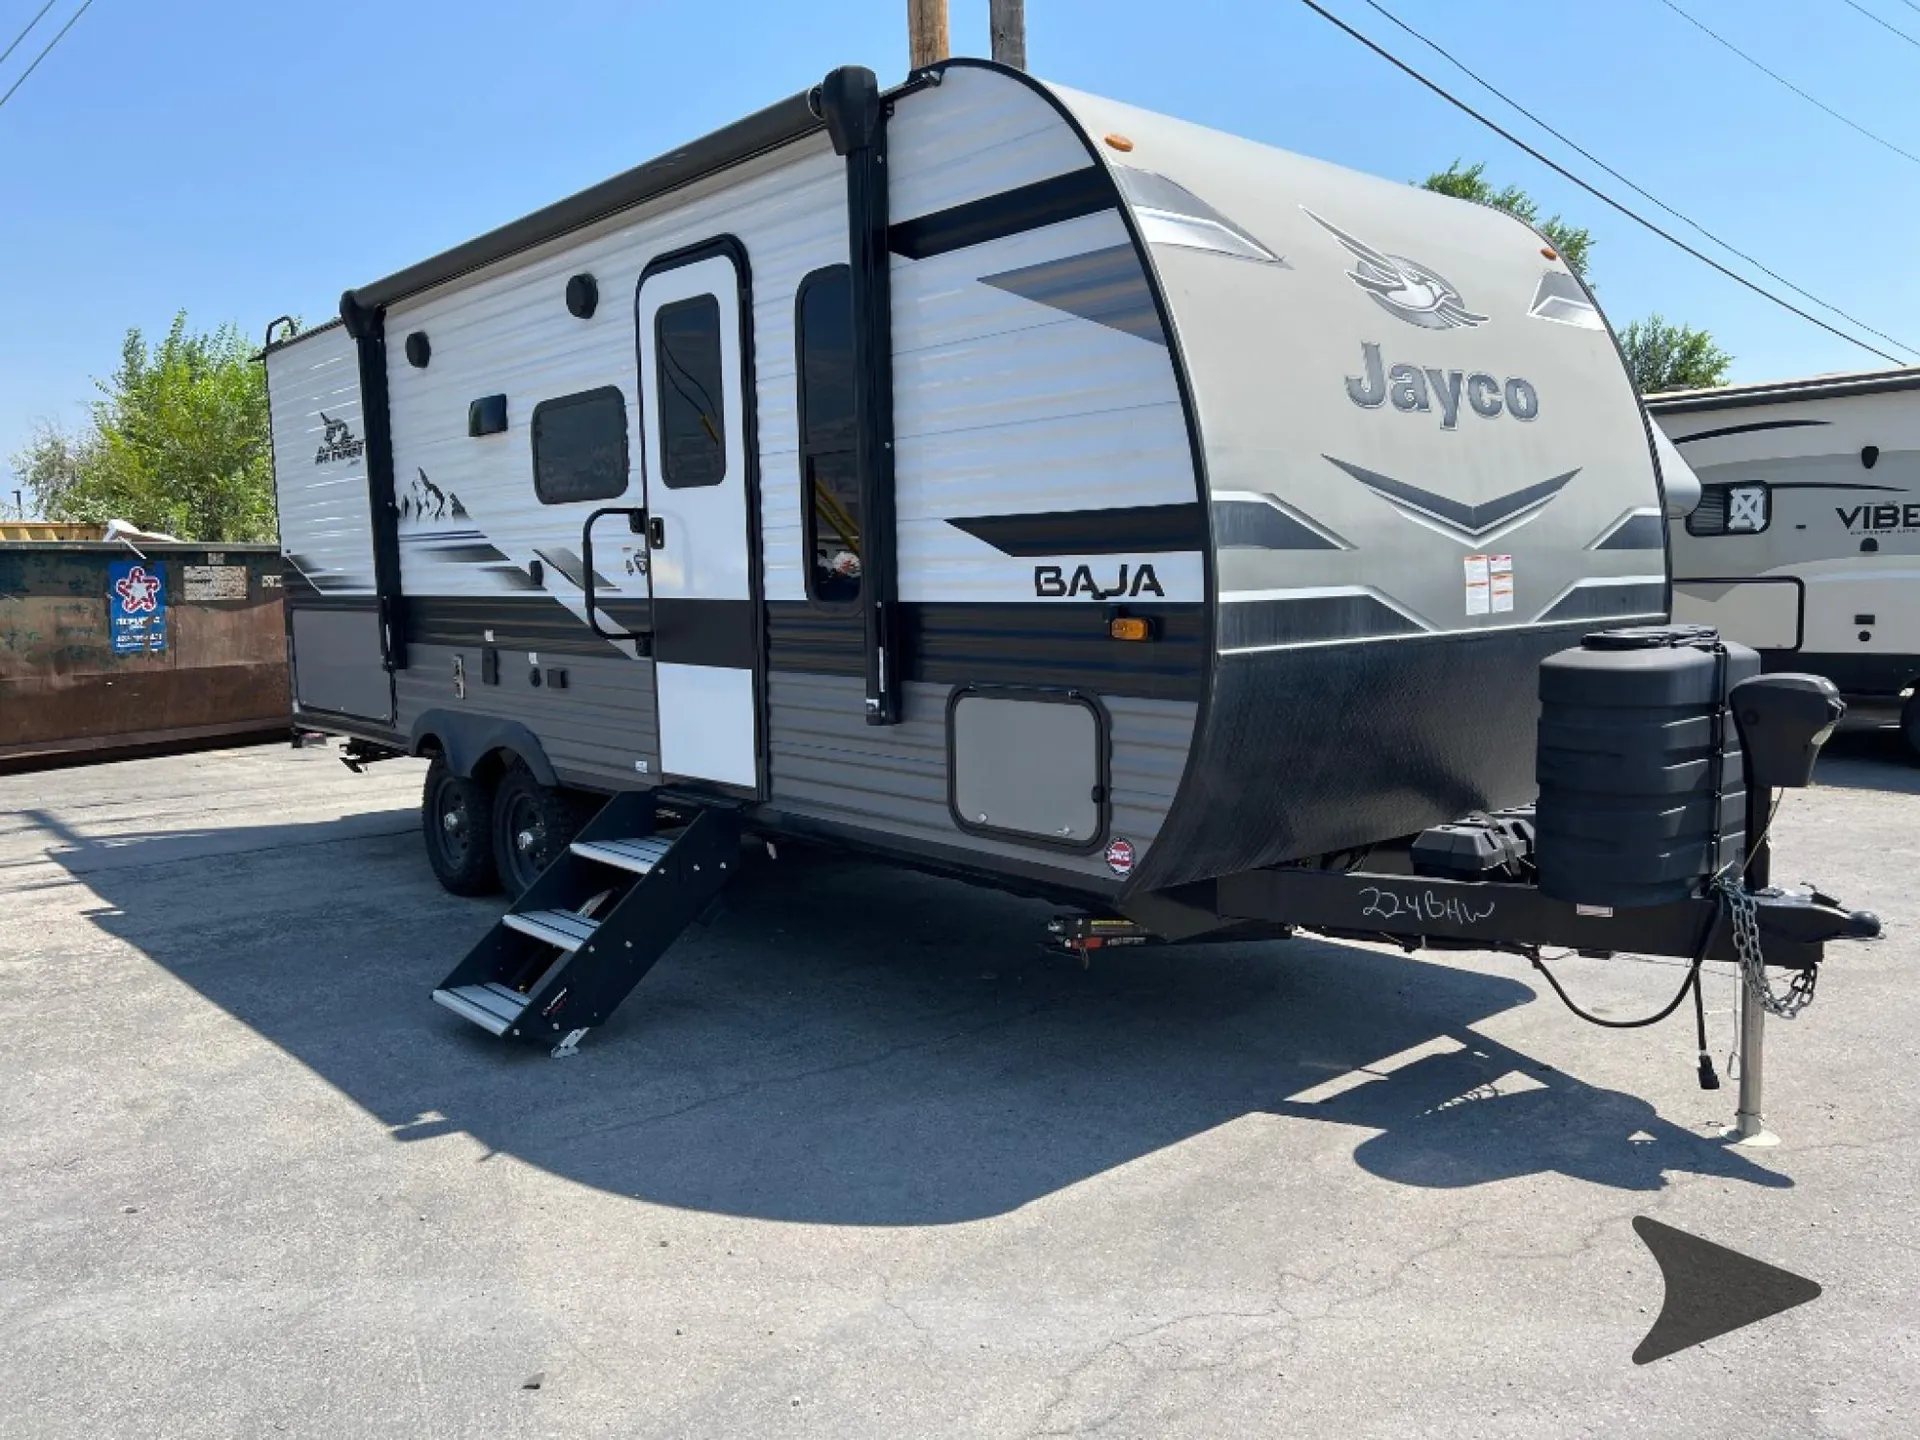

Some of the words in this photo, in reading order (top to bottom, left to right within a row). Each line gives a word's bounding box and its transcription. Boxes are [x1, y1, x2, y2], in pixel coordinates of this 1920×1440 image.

[1344, 340, 1539, 431] Jayco
[1835, 504, 1920, 529] VIBE
[1034, 564, 1165, 597] BAJA
[1358, 886, 1496, 926] 224BHW
